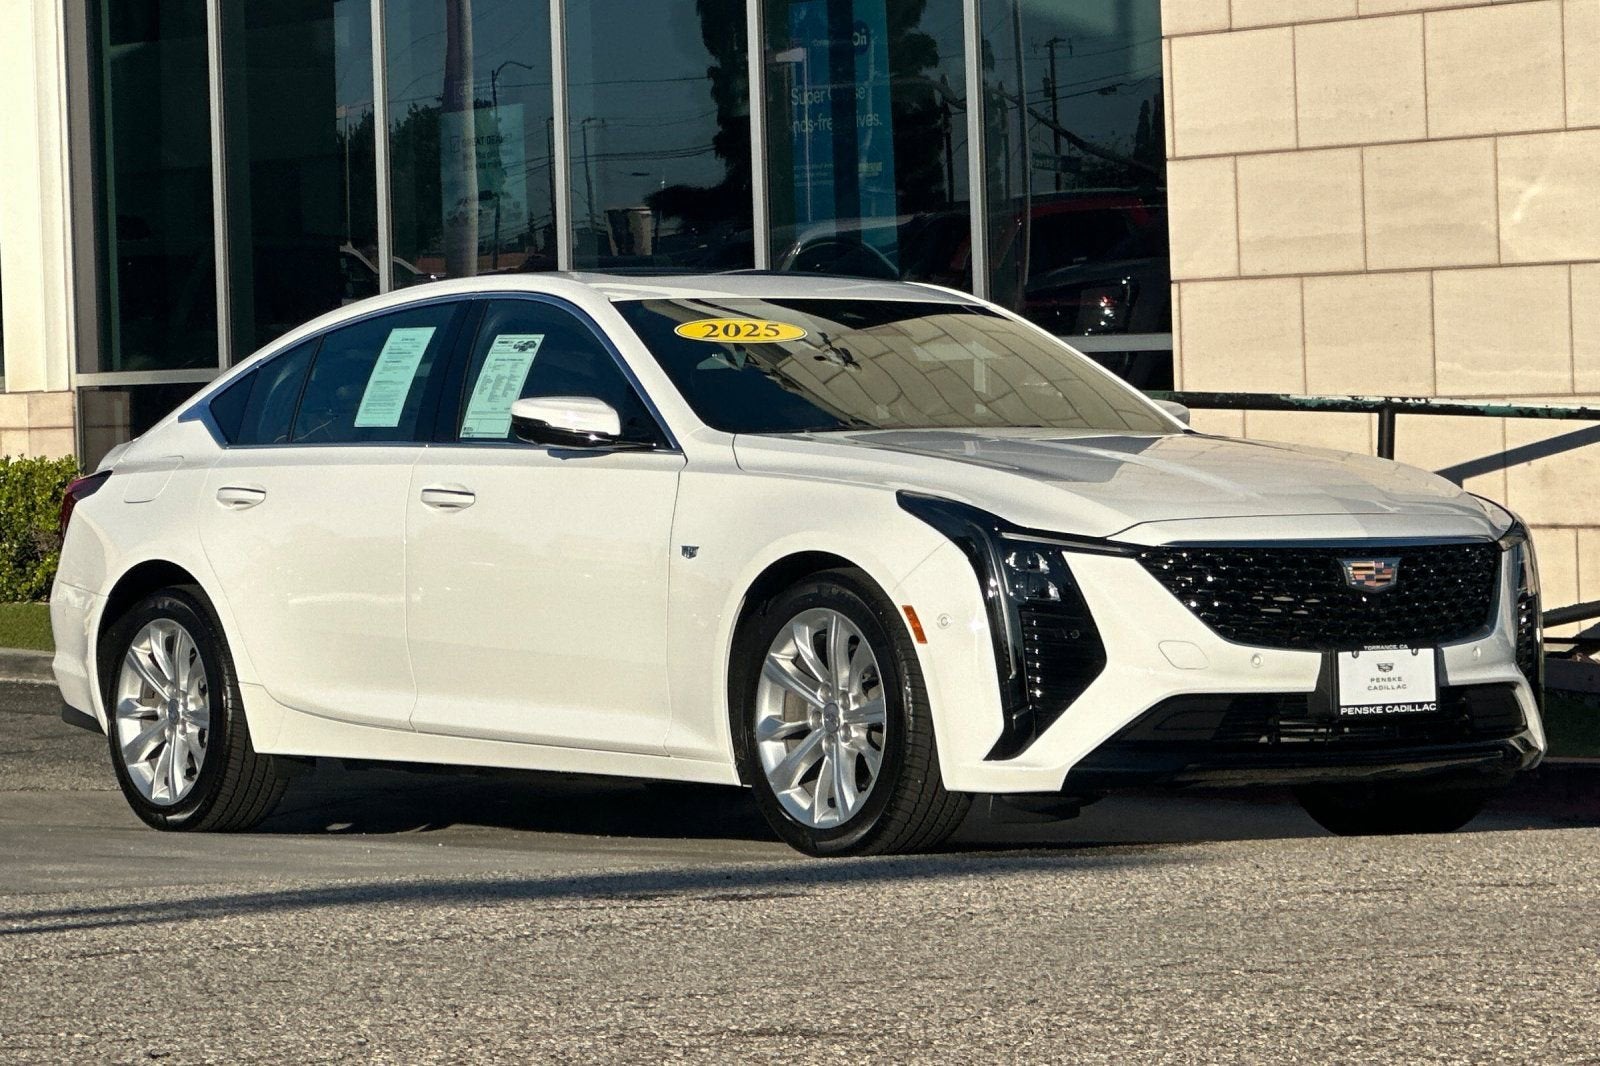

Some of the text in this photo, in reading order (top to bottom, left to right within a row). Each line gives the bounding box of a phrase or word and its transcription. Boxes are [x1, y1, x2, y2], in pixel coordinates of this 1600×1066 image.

[702, 323, 780, 338] 2025
[1340, 703, 1437, 715] PENSKE CADILLAC
